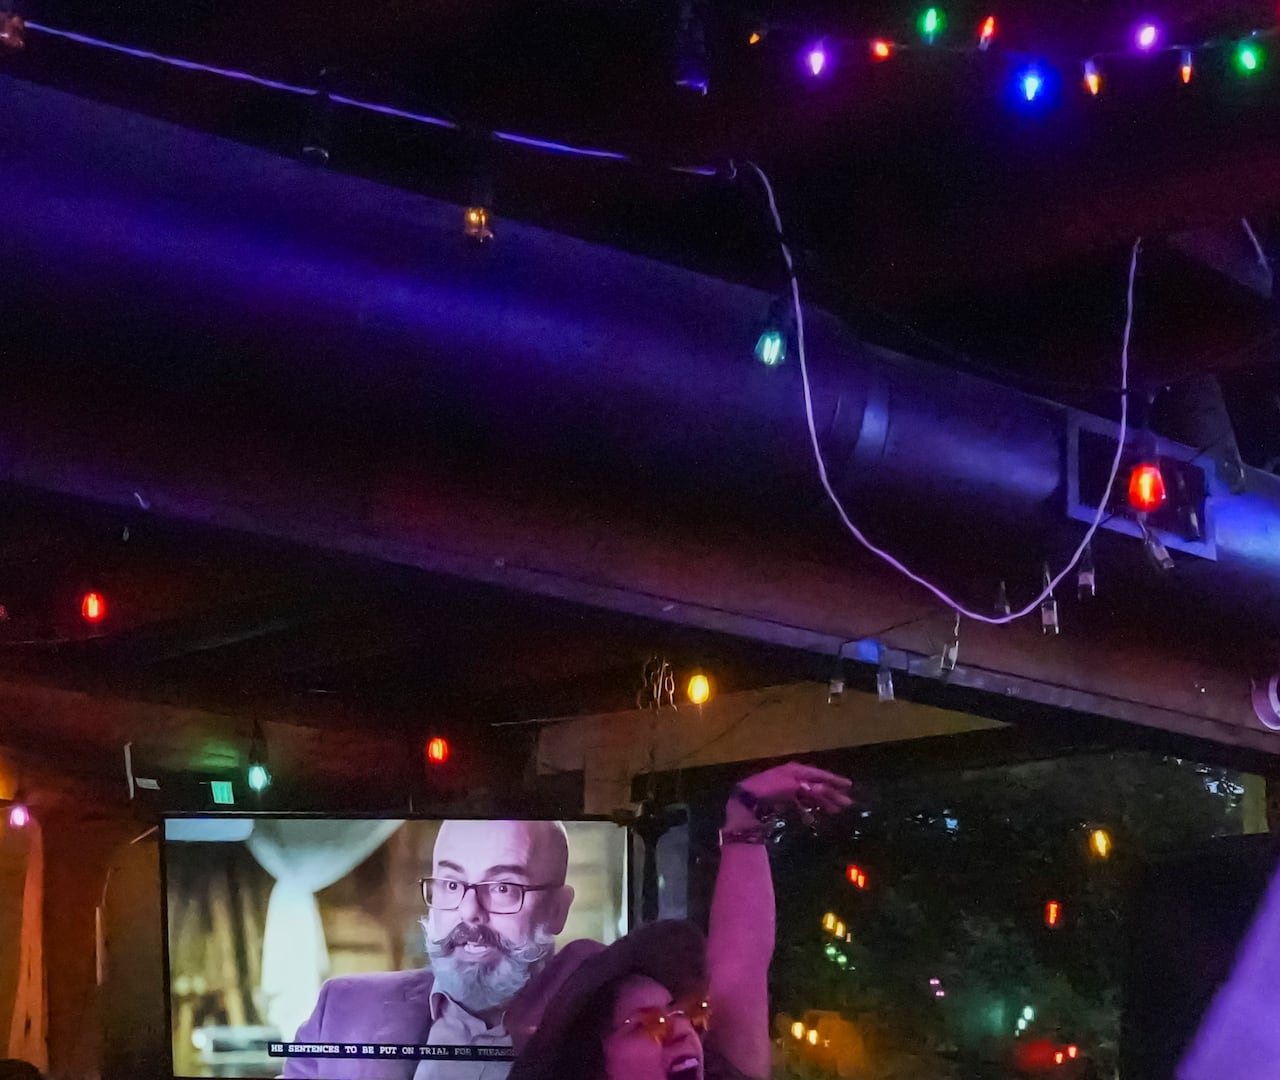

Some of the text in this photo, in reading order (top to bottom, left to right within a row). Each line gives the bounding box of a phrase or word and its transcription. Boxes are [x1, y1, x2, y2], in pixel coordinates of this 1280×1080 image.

[271, 1044, 284, 1053] HE
[288, 1044, 340, 1054] SENTENCES
[344, 1045, 357, 1054] TO
[362, 1045, 374, 1054] BE
[379, 1046, 397, 1055] PUT
[402, 1046, 414, 1055] ON
[419, 1047, 449, 1056] TRIAL
[454, 1048, 472, 1056] FOR
